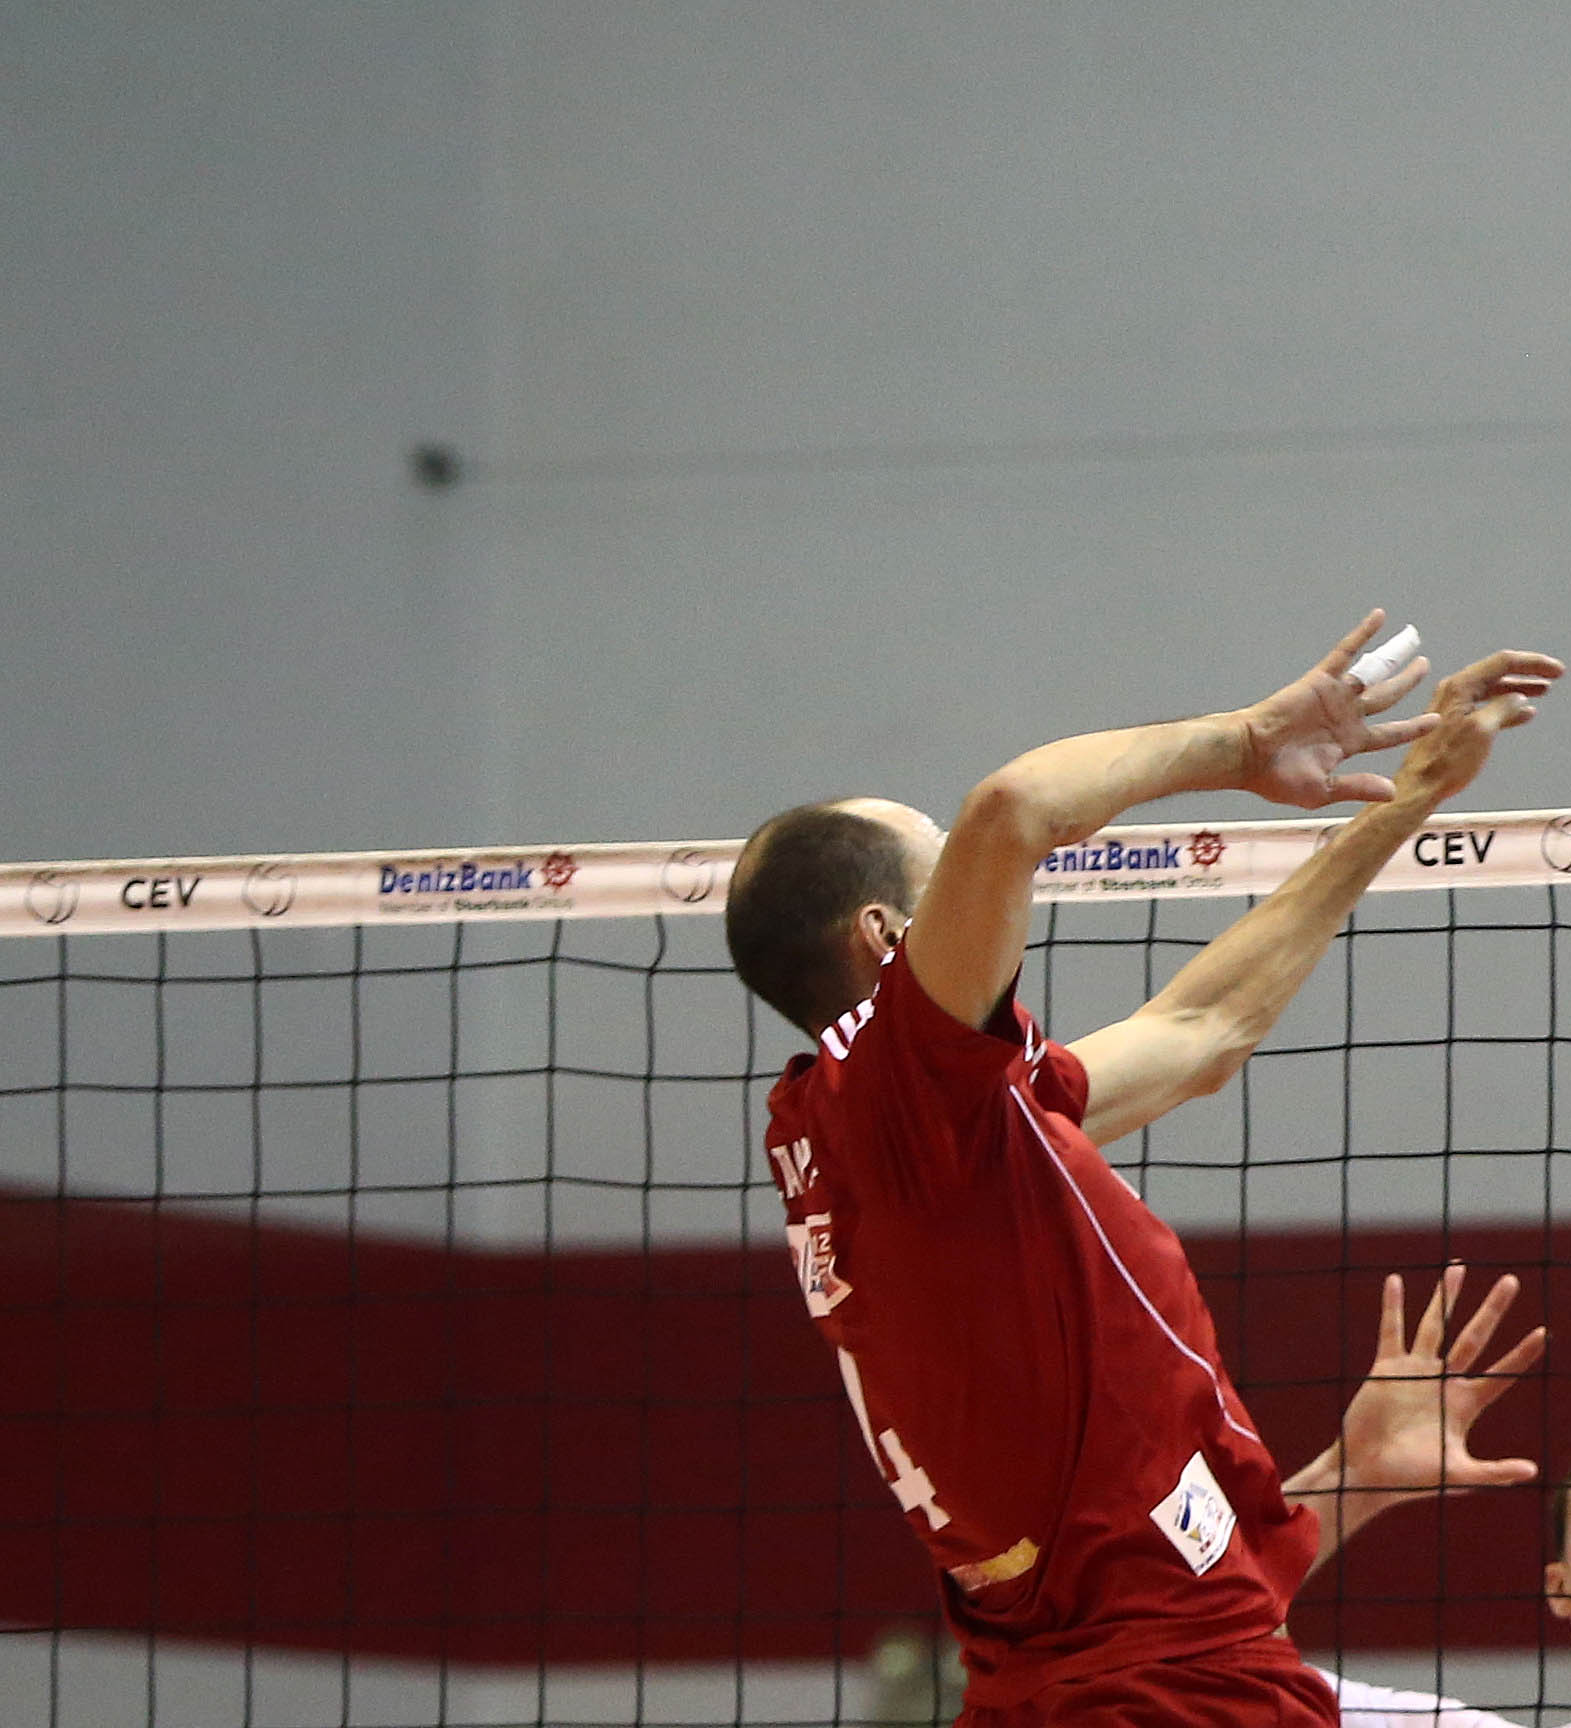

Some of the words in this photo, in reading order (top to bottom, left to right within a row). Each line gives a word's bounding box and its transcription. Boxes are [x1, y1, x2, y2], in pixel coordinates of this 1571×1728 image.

[1034, 838, 1180, 872] enizBank
[1414, 830, 1497, 867] CEV
[121, 875, 203, 910] CEV
[379, 860, 535, 894] DenizBank
